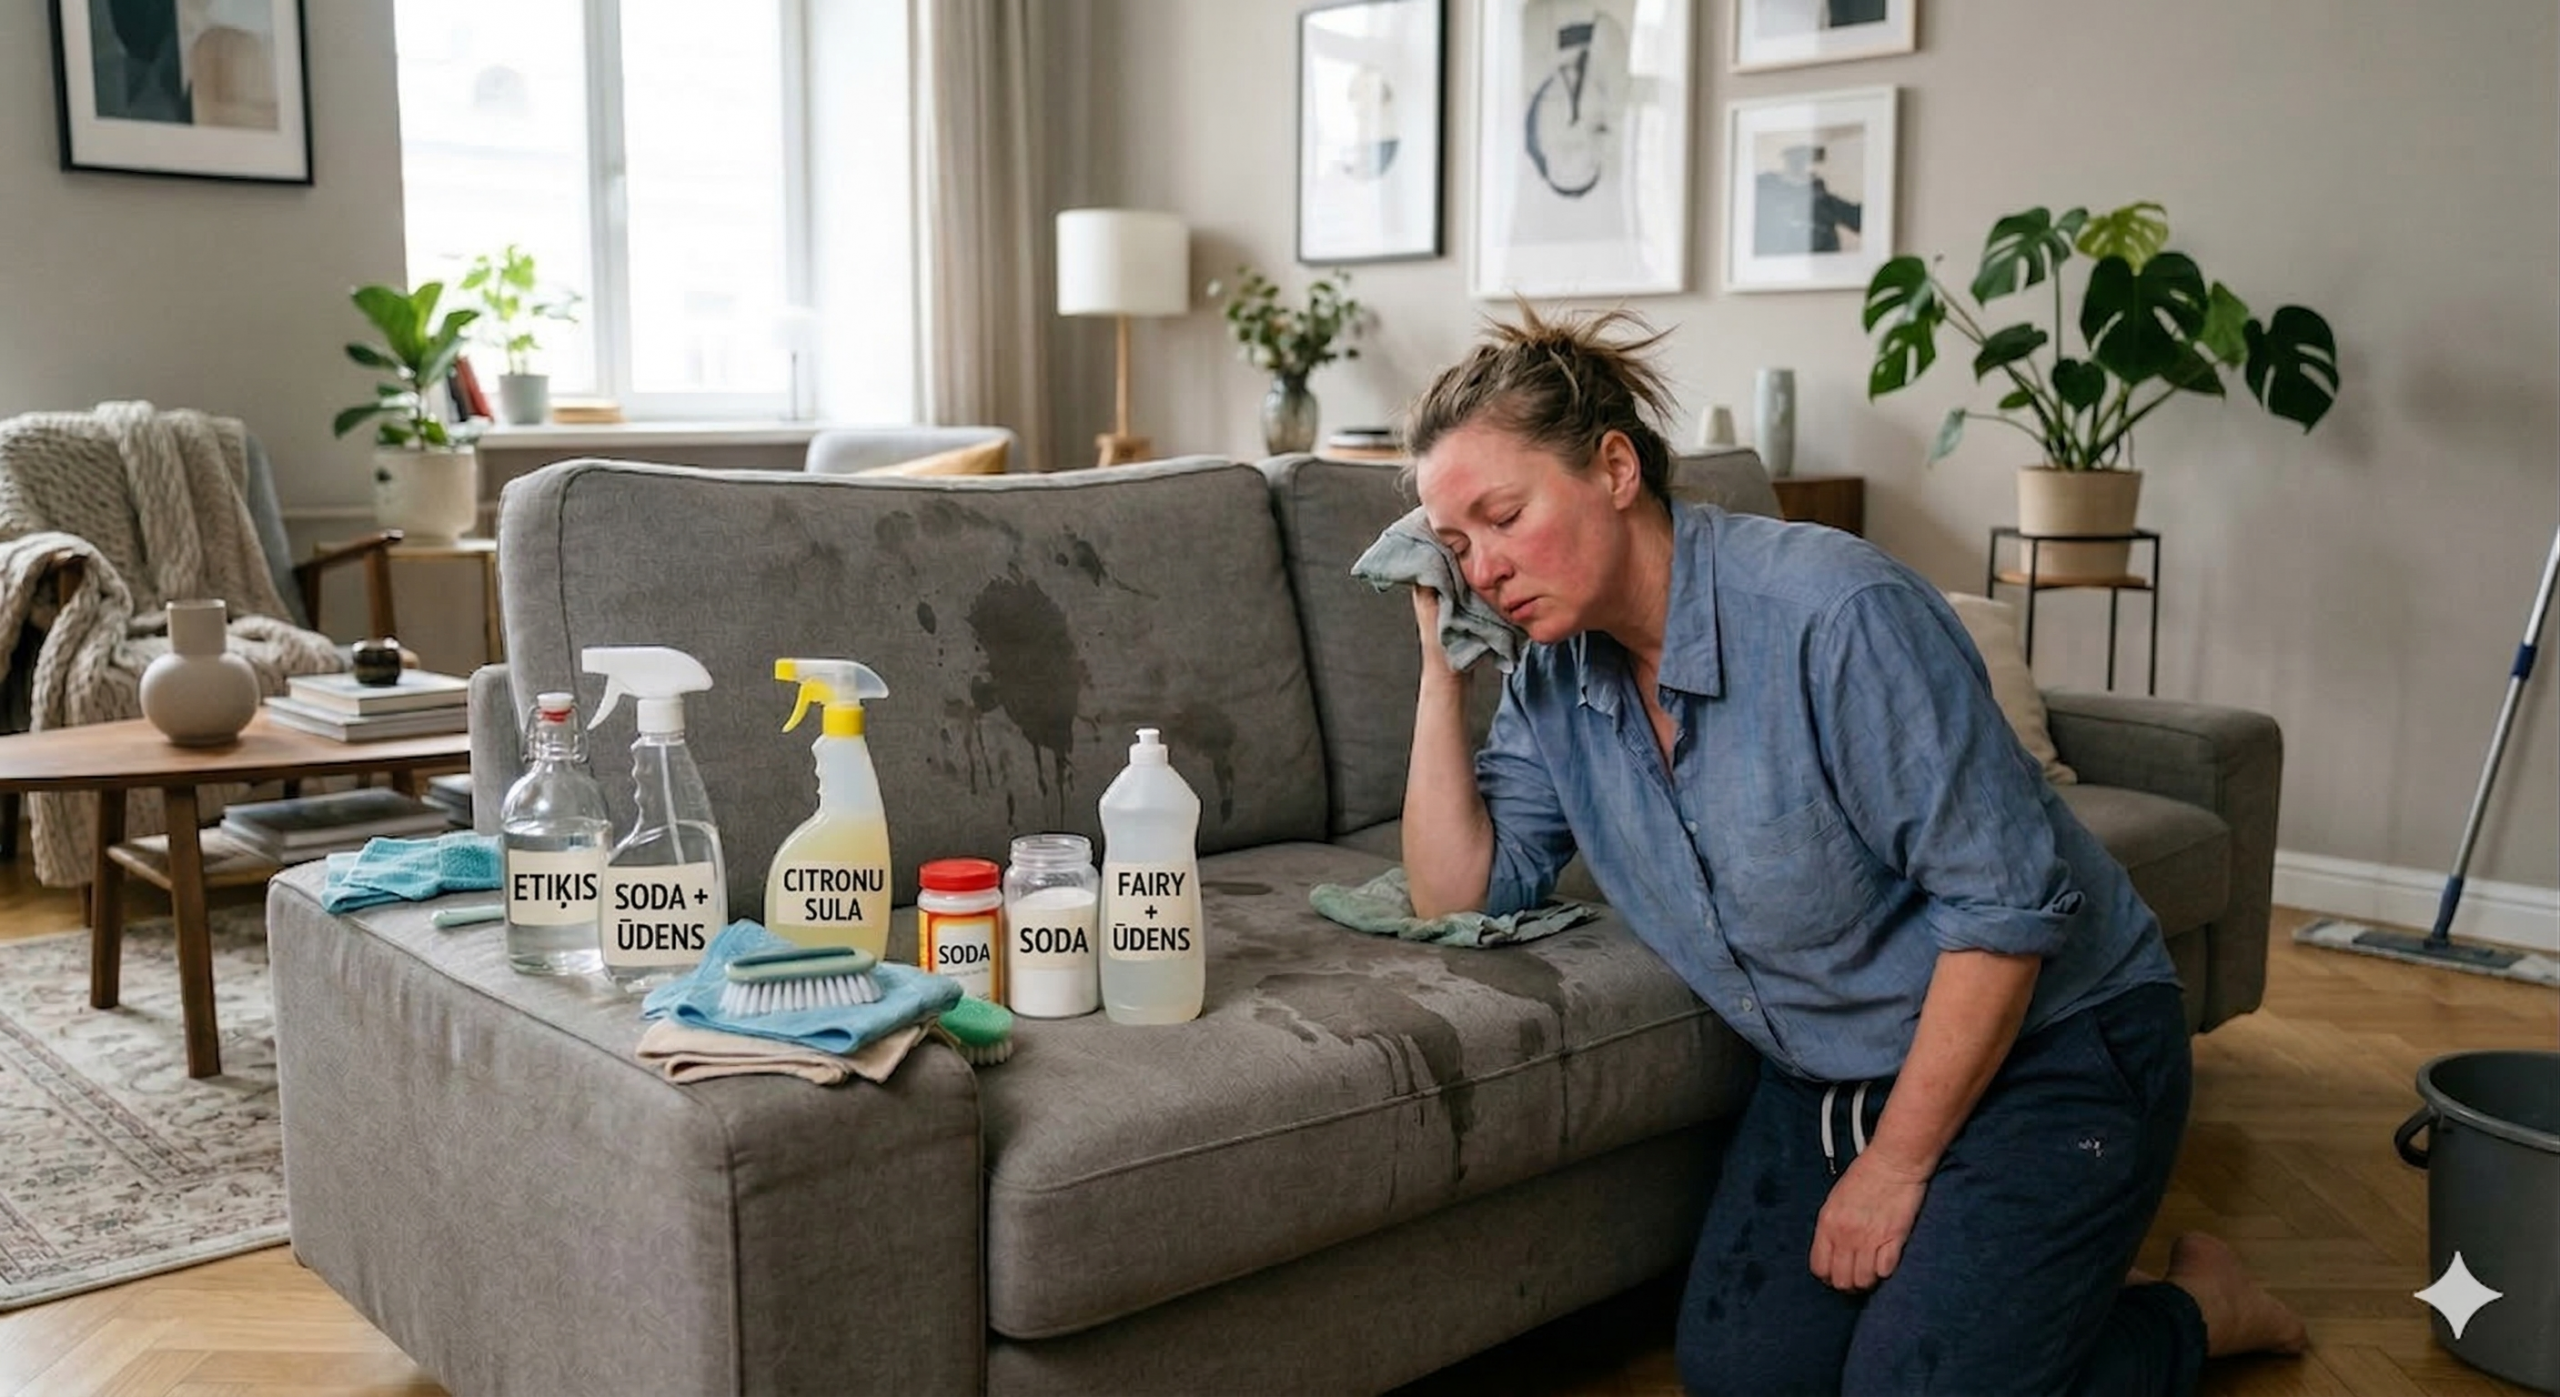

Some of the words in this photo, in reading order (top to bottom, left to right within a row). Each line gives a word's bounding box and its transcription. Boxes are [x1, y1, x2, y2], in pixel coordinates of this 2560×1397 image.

[513, 873, 598, 909] ETIĶIS
[783, 868, 884, 893] CITRONU
[1117, 872, 1186, 897] FAIRY
[615, 883, 687, 910] SODA
[693, 888, 709, 905] +
[805, 897, 863, 921] SULA
[1144, 904, 1158, 920] +
[617, 918, 706, 951] ŪDENS
[1019, 927, 1089, 954] SODA
[1112, 922, 1191, 952] ŪDENS
[938, 943, 990, 965] SODA
